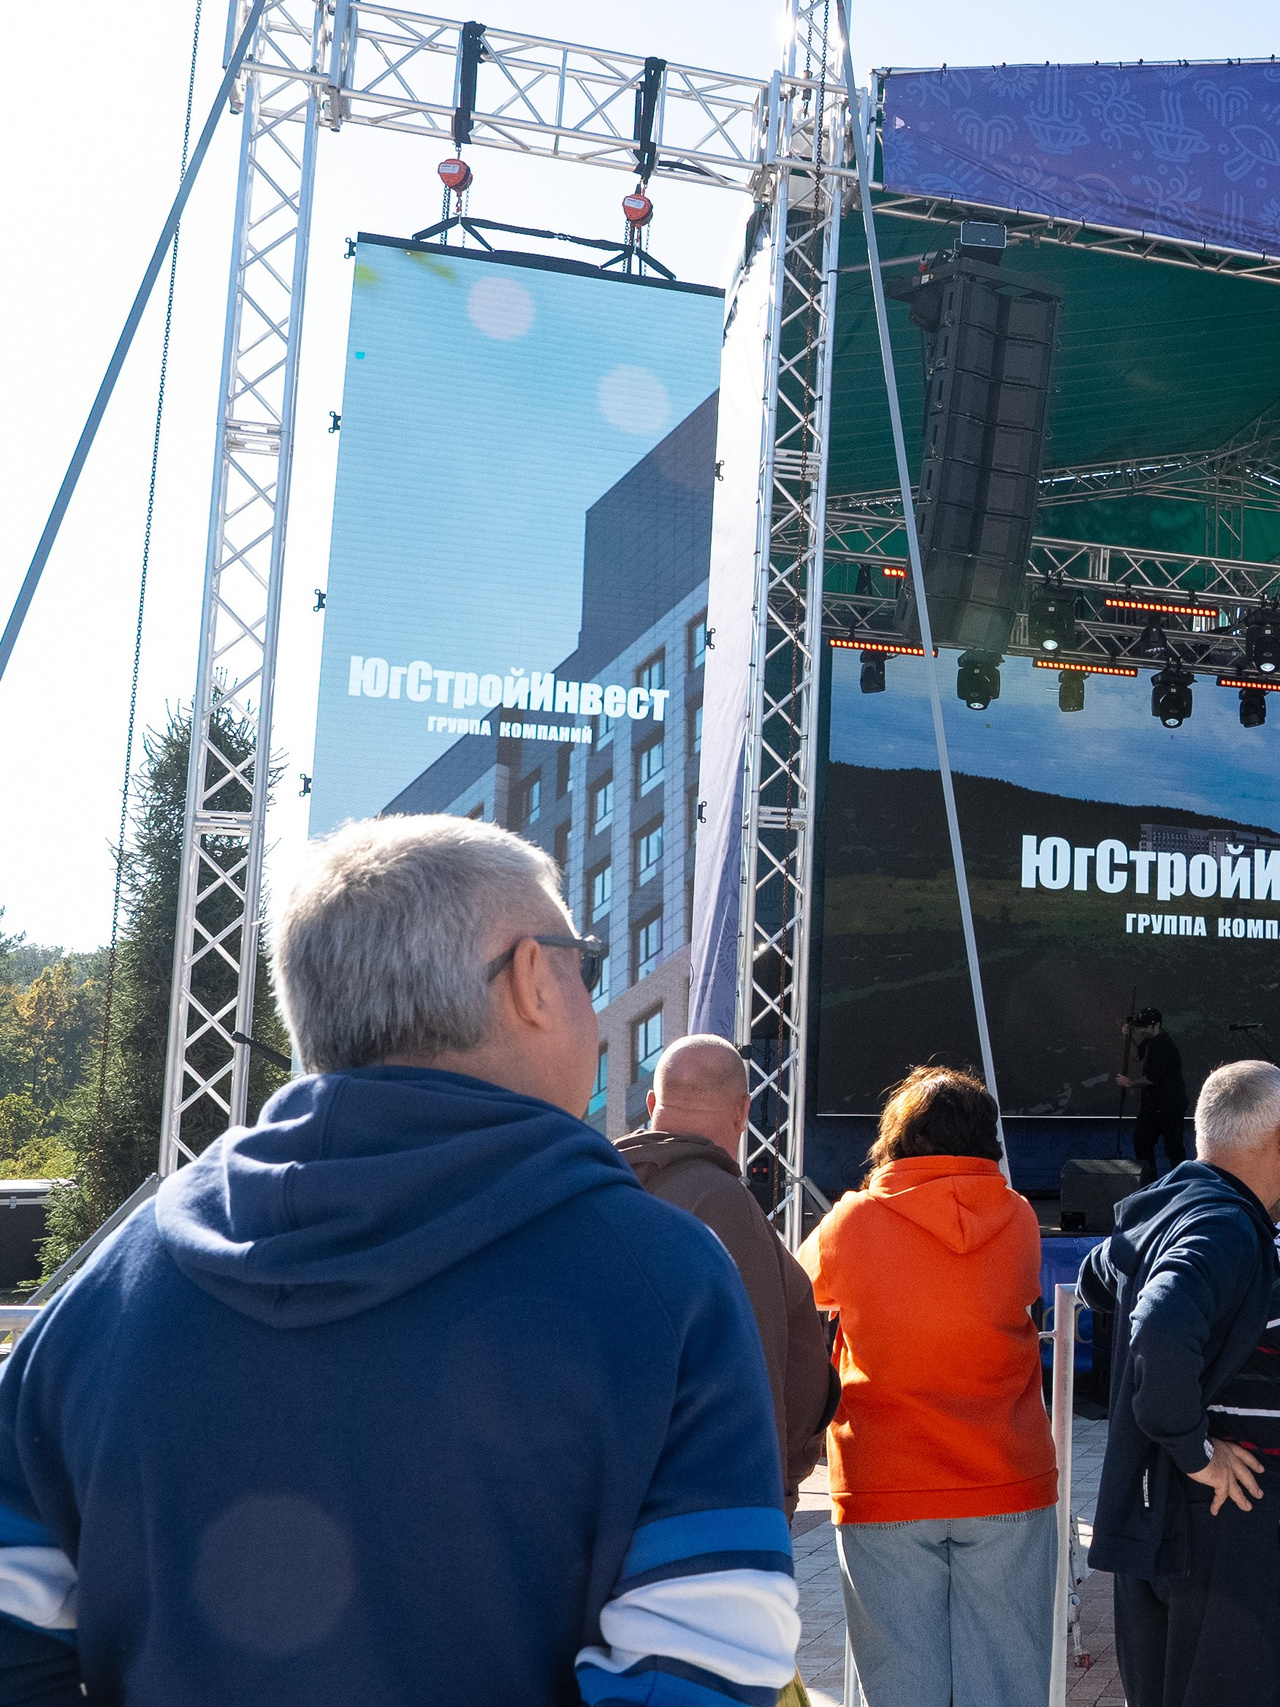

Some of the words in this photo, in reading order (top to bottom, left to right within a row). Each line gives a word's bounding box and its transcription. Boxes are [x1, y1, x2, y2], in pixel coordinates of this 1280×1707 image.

[348, 655, 670, 721] ЮгСтройИнвест
[427, 715, 492, 736] ГРУППА
[499, 721, 593, 744] КОМПАНИЙ
[1126, 912, 1207, 937] ГРУППА
